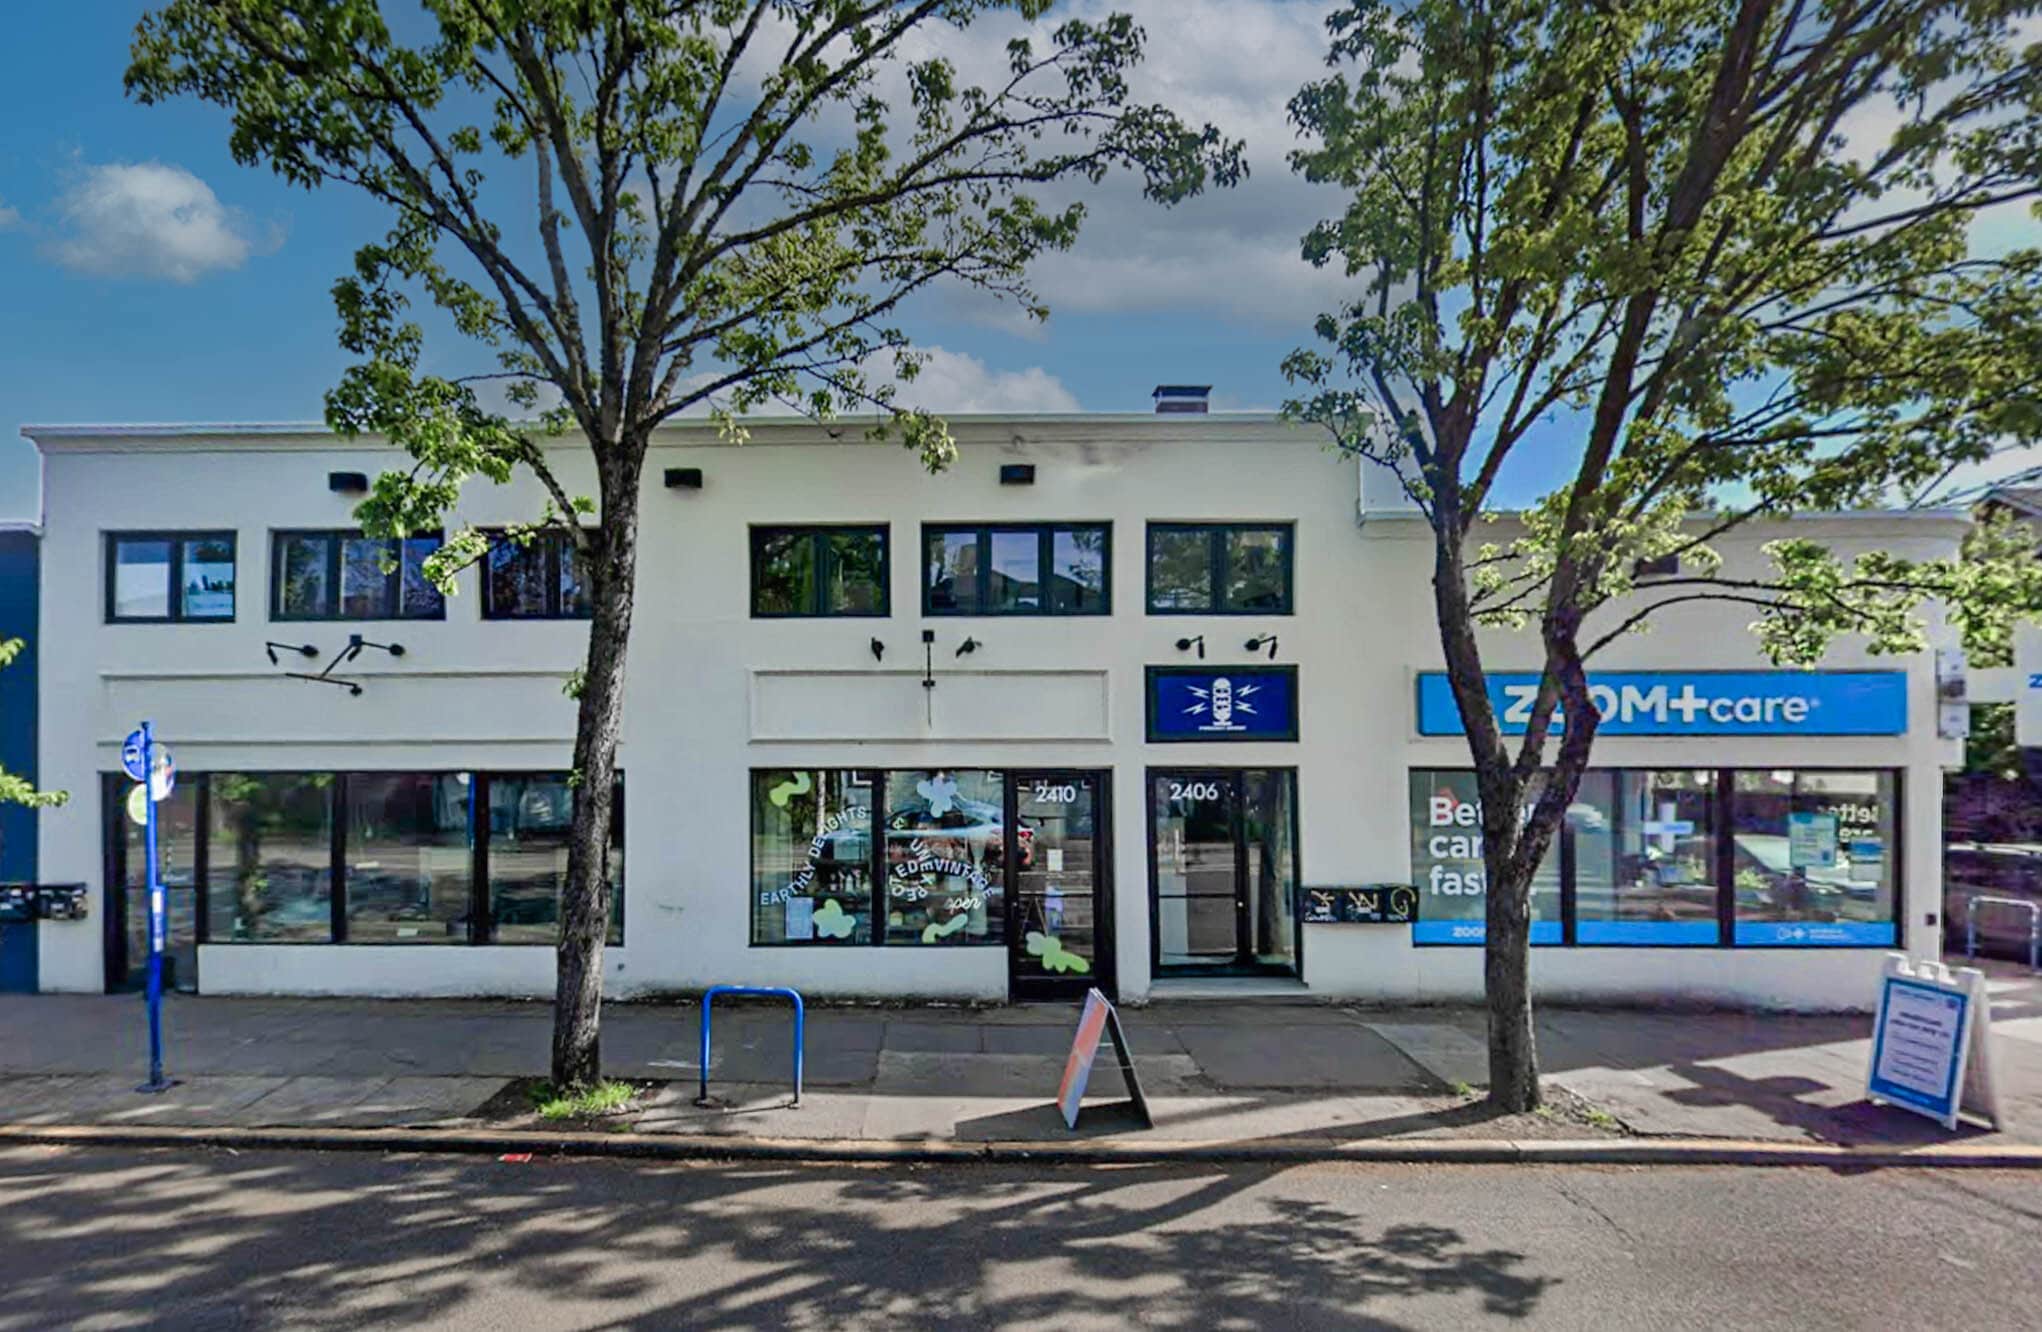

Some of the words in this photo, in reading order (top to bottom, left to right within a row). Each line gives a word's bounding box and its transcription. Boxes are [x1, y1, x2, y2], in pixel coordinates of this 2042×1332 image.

[1504, 684, 1810, 724] ZOM+care
[1035, 785, 1077, 803] 2410
[1170, 782, 1219, 801] 2406
[760, 859, 816, 906] EARTHLY
[807, 805, 867, 859] DELIGHTS
[934, 858, 995, 900] VINTAGE
